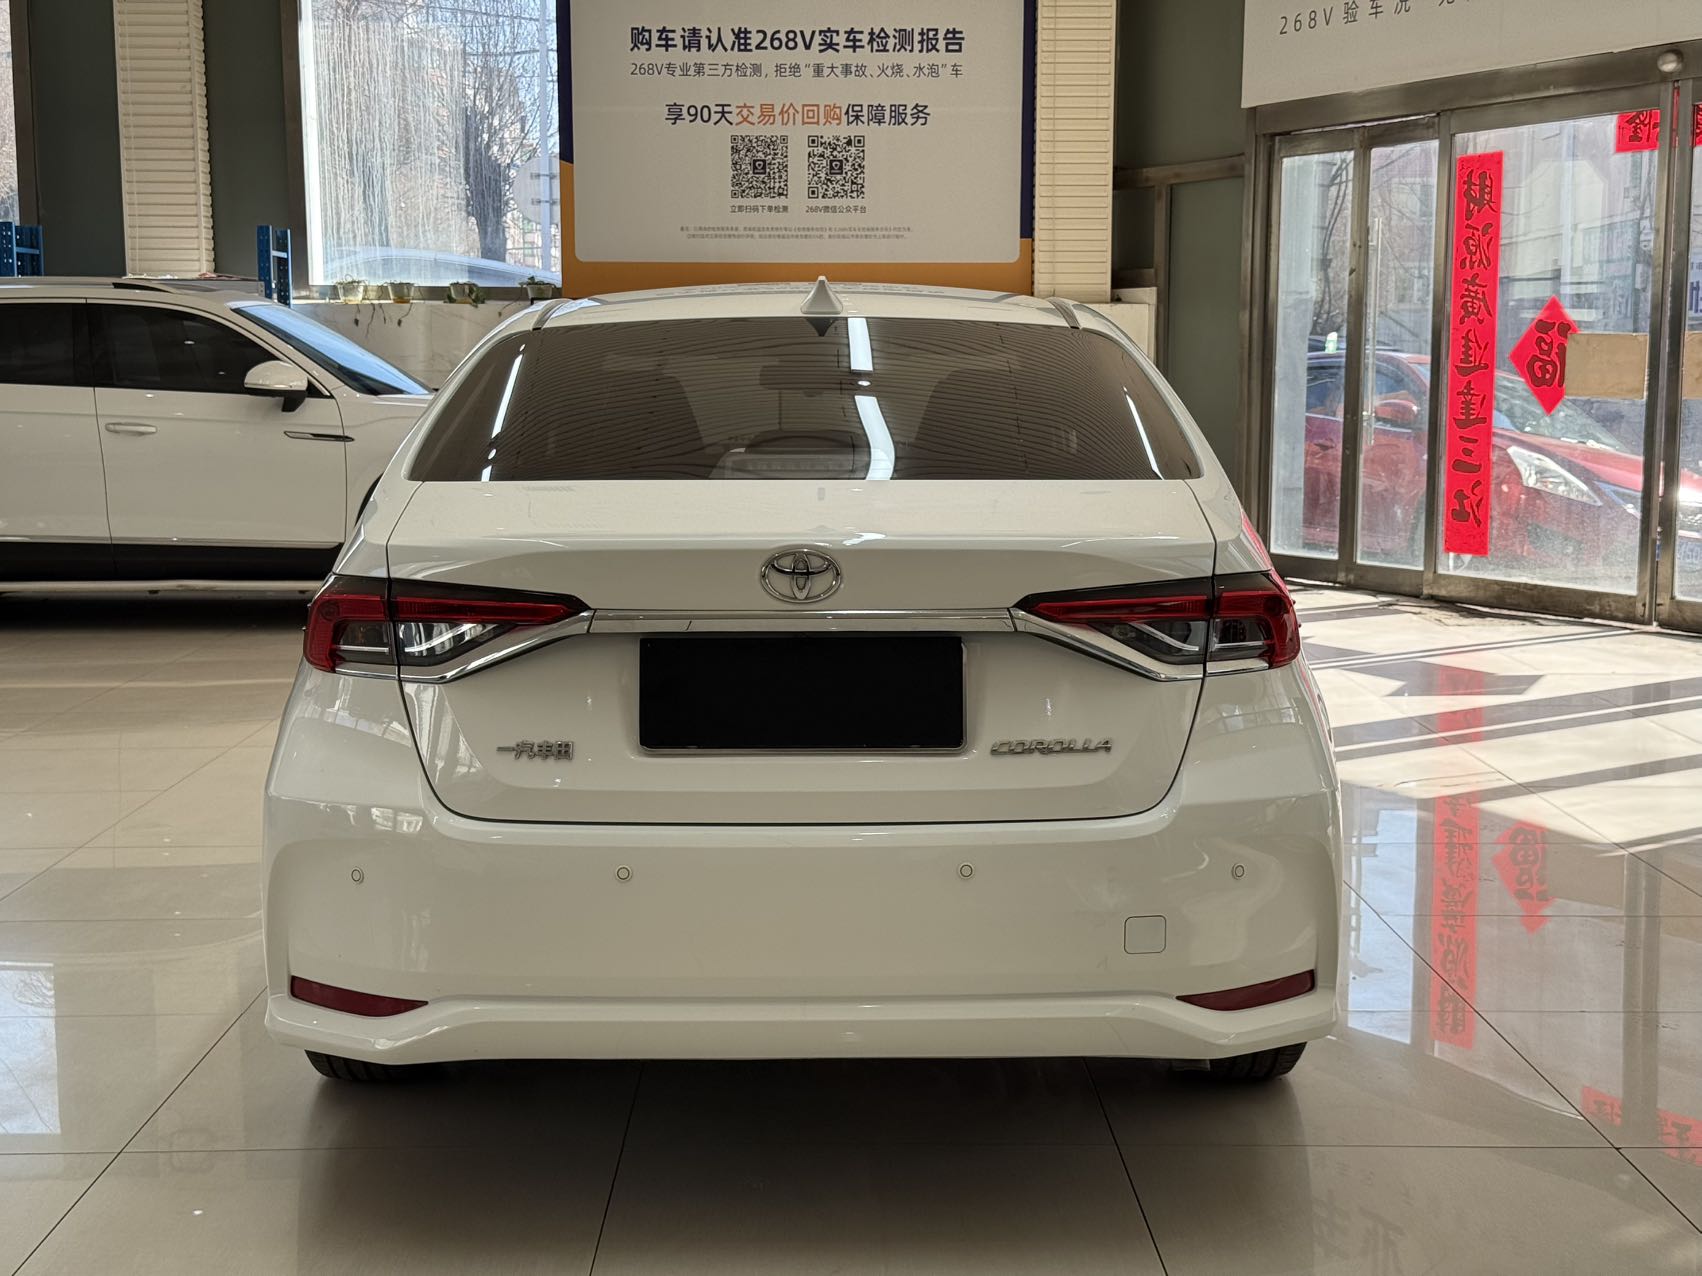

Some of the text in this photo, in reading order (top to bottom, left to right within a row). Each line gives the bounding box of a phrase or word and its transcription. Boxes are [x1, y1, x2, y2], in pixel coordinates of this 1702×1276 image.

[630, 26, 965, 54] 购车请认准268V实车检测报告
[665, 102, 931, 126] 享90天交易价回购保障服务
[730, 205, 789, 214] 立即扫码下单检测
[805, 205, 867, 214] 268V微信公众平台
[496, 740, 574, 761] 一汽丰田
[990, 738, 1112, 756] COROLLA
